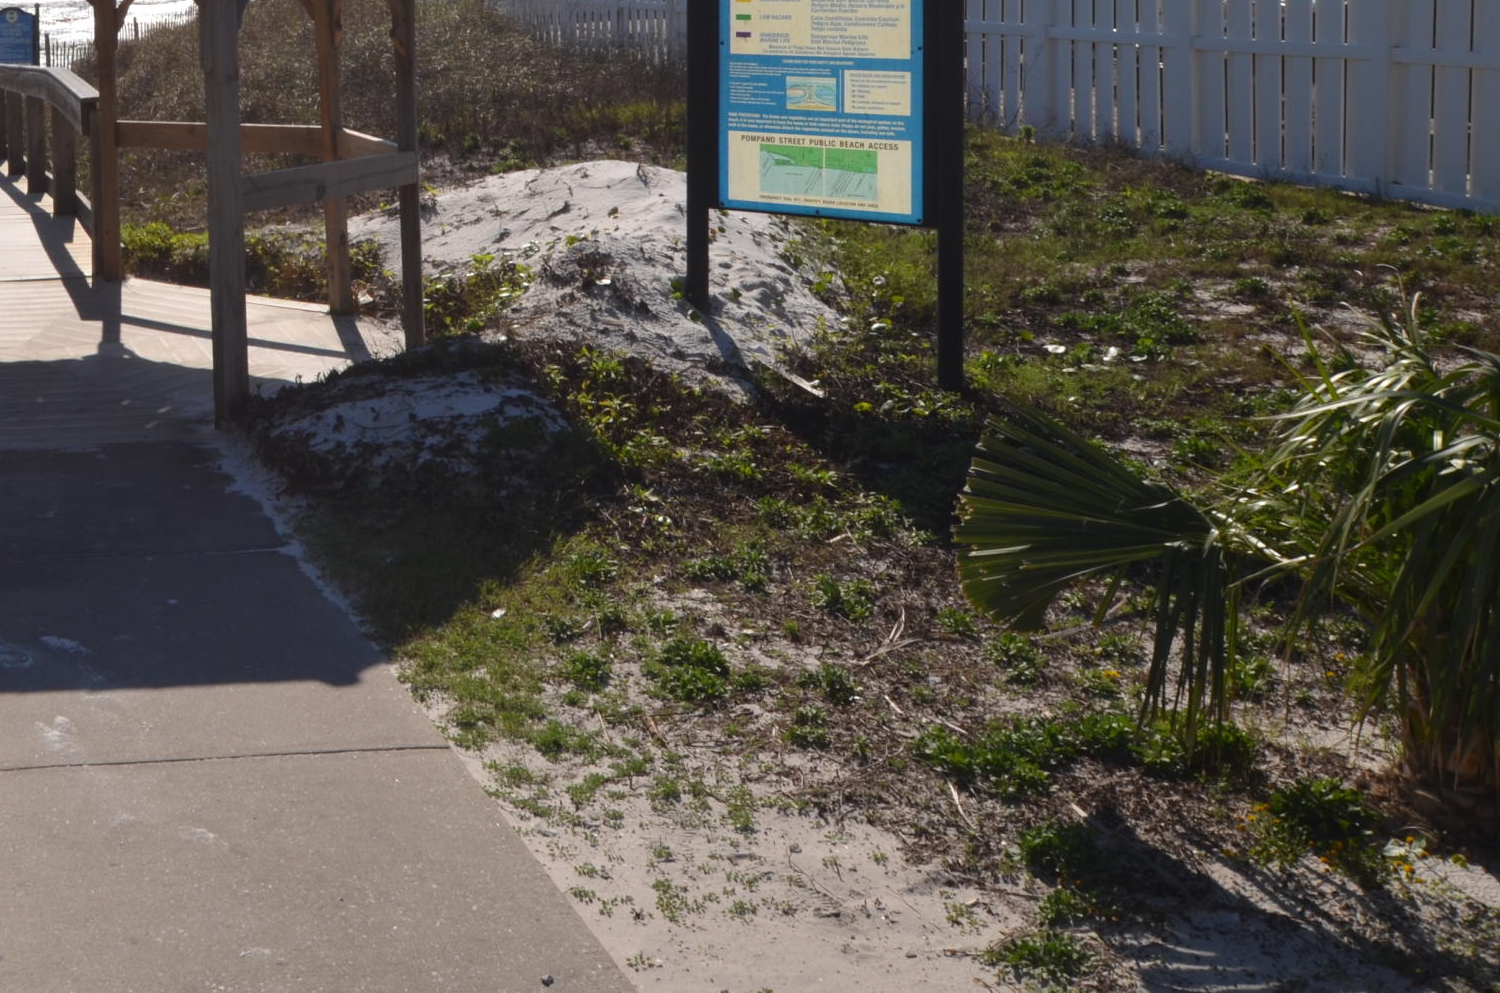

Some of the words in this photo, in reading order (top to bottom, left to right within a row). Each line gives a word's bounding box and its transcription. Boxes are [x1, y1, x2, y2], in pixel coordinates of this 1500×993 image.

[741, 134, 775, 144] POMPANO
[779, 136, 805, 145] STREET
[809, 138, 836, 147] PUBLIC
[839, 140, 864, 149] BEACH
[868, 142, 899, 151] ACCESS
